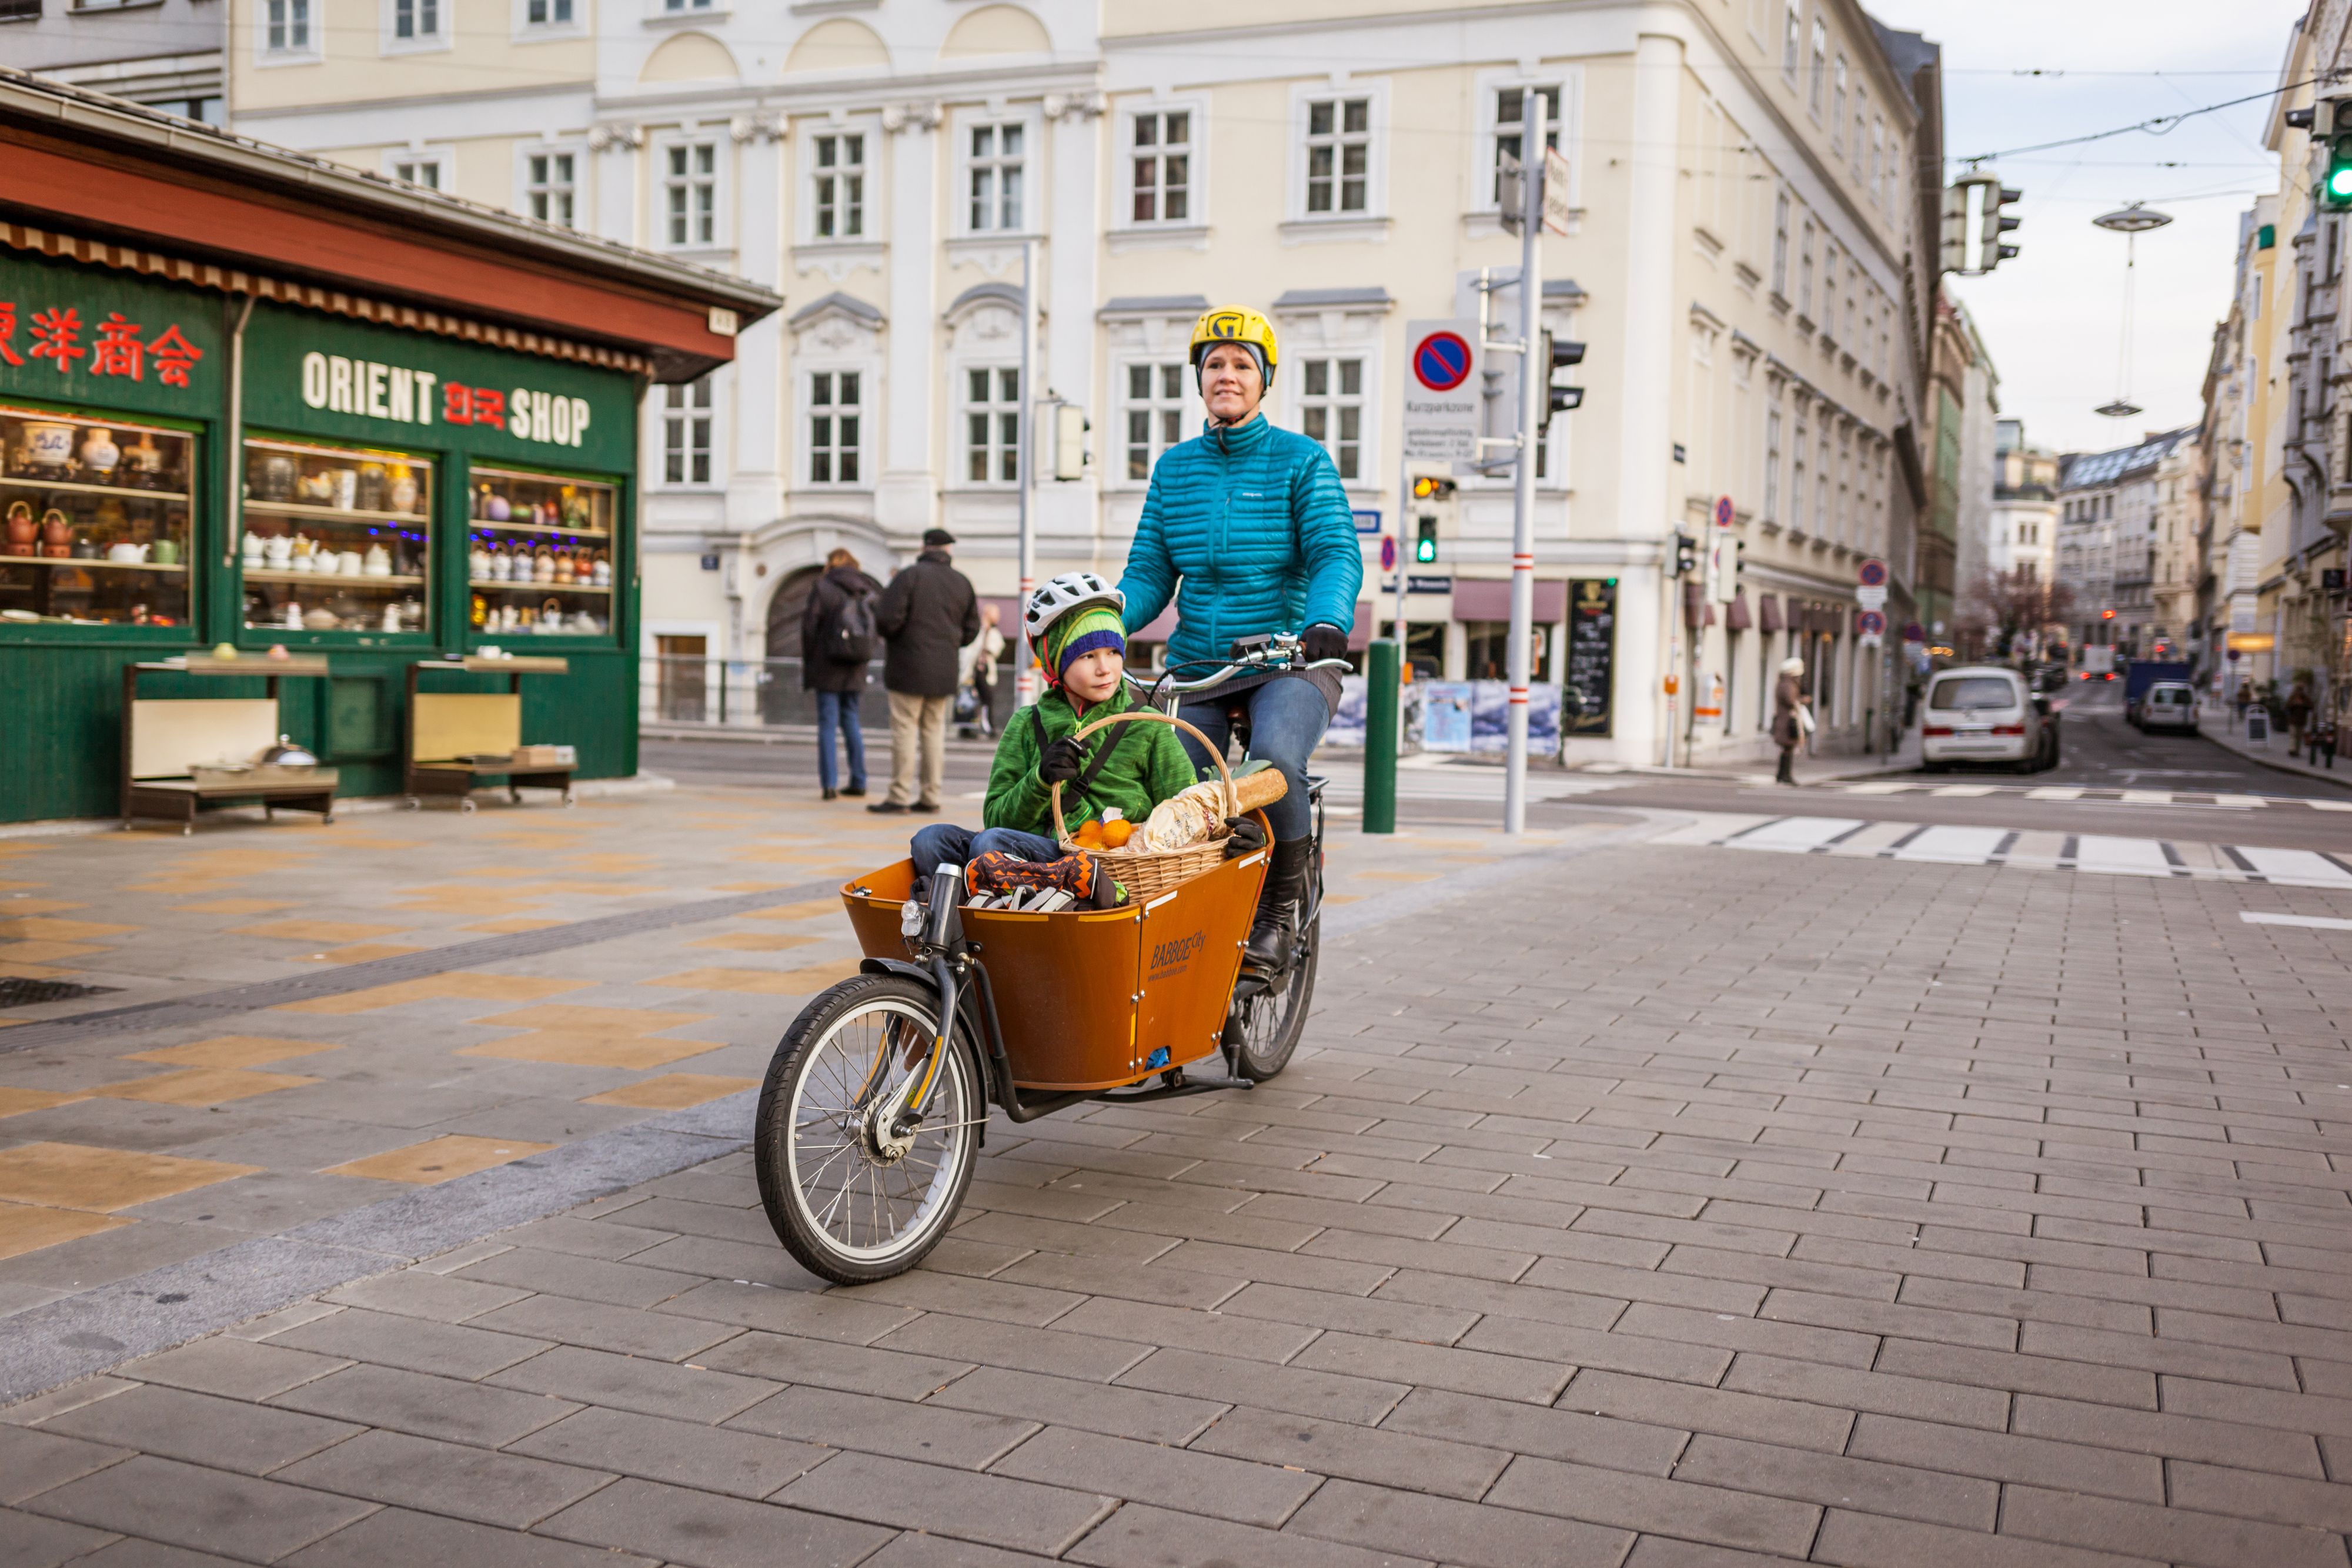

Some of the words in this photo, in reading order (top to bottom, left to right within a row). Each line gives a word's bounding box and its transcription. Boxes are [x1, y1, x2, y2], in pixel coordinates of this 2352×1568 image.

[302, 352, 436, 425] ORIENT
[509, 387, 590, 447] SHOP
[1150, 937, 1192, 969] BABBOE
[1192, 930, 1207, 952] City
